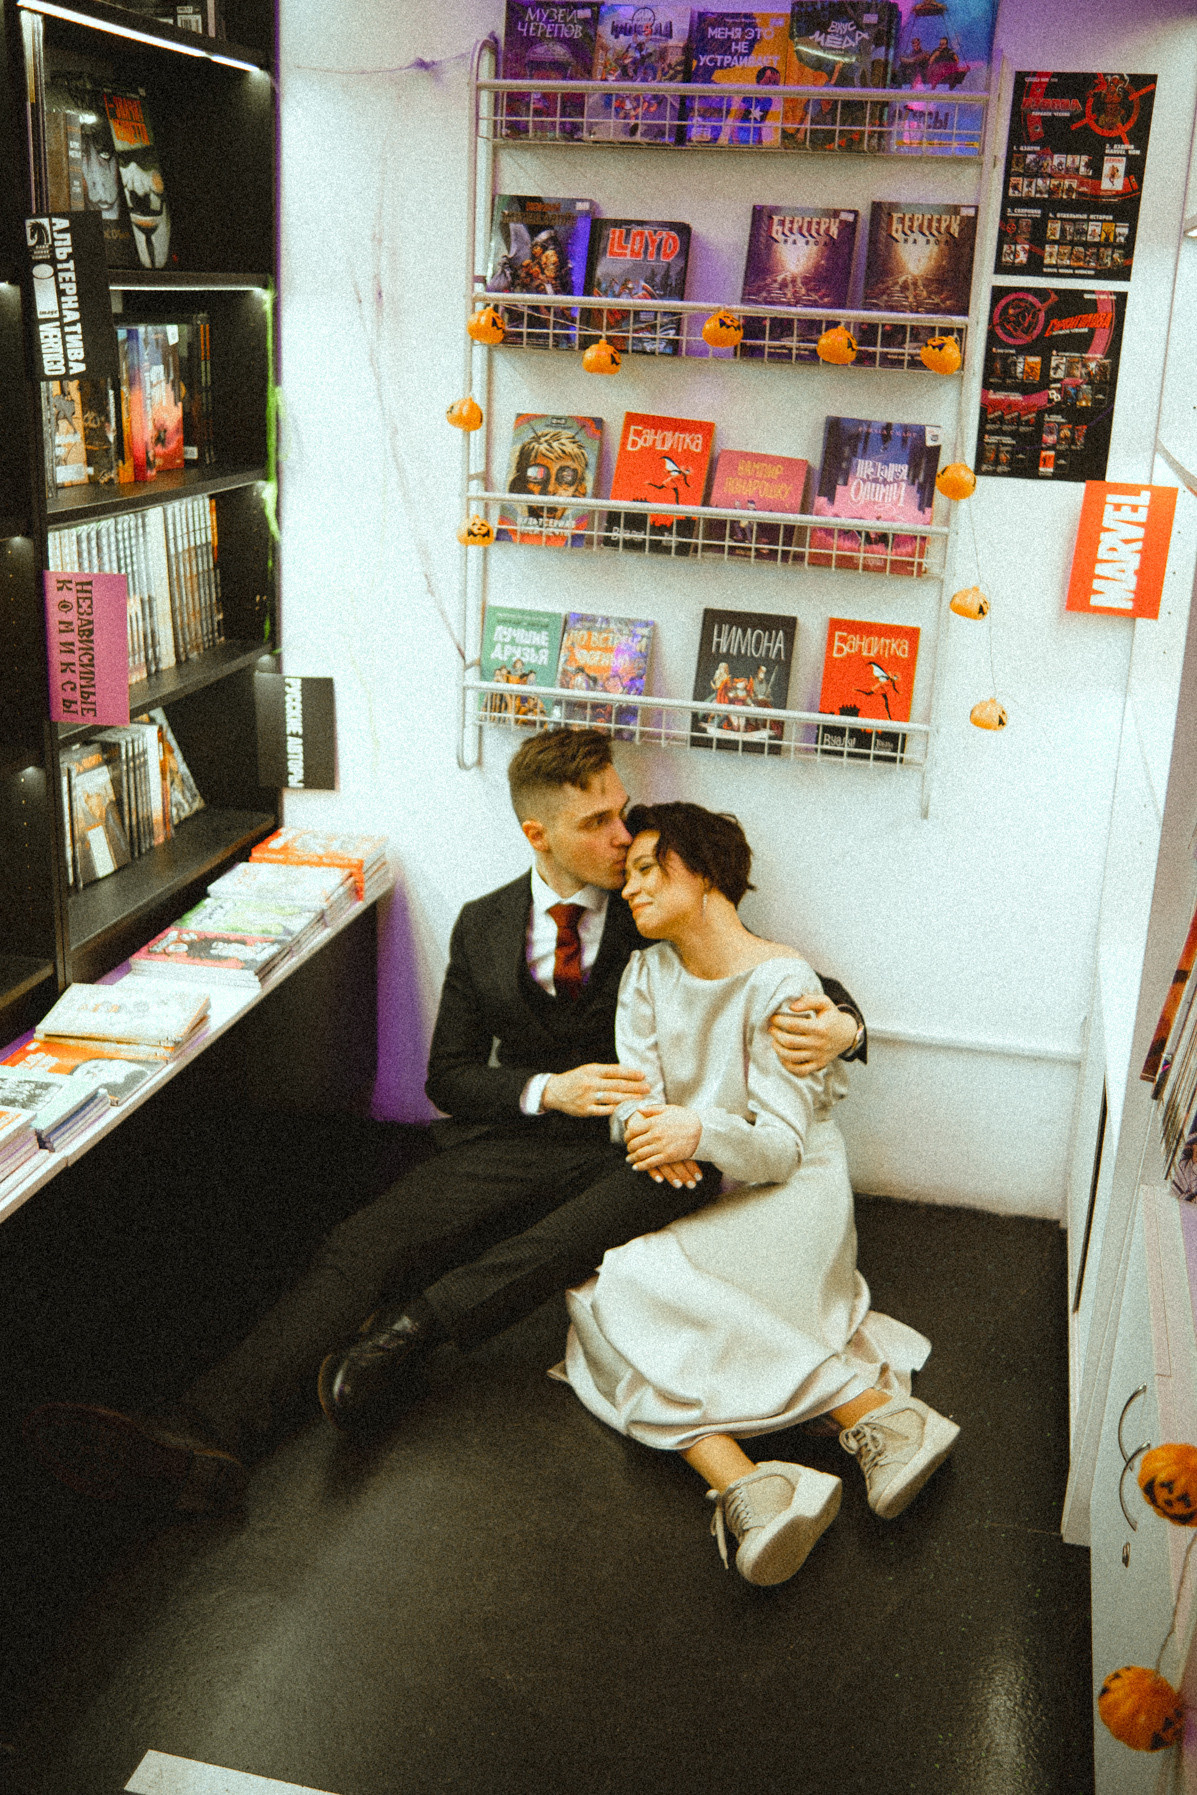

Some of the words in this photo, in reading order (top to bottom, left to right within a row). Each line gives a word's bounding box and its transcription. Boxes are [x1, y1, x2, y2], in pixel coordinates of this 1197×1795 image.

[517, 22, 583, 39] ЧЕРЕПОВ
[525, 7, 579, 23] МУЗЕЙ
[707, 27, 742, 39] МЕНЯ
[744, 28, 775, 40] ЭТО
[731, 41, 750, 53] НЕ
[698, 55, 780, 68] УСТРАИВАЕТ
[606, 228, 680, 261] LLOYD
[51, 217, 86, 375] АЛЬТЕРНАТИВА
[38, 321, 66, 376] VERTIGO
[626, 425, 704, 453] Бандитка
[1089, 490, 1151, 610] MARVEL
[56, 579, 78, 715] КОМИКСЫ
[75, 580, 98, 718] НЕЗАВИСИМЫЕ
[493, 625, 550, 648] ЛУЧШИЕ
[711, 623, 786, 661] НИМОНА
[832, 630, 910, 659] Бандитка
[490, 642, 550, 666] ДРУЗЬЯ
[284, 677, 303, 736] РУССКИЕ
[286, 736, 305, 788] АВТОРЫ
